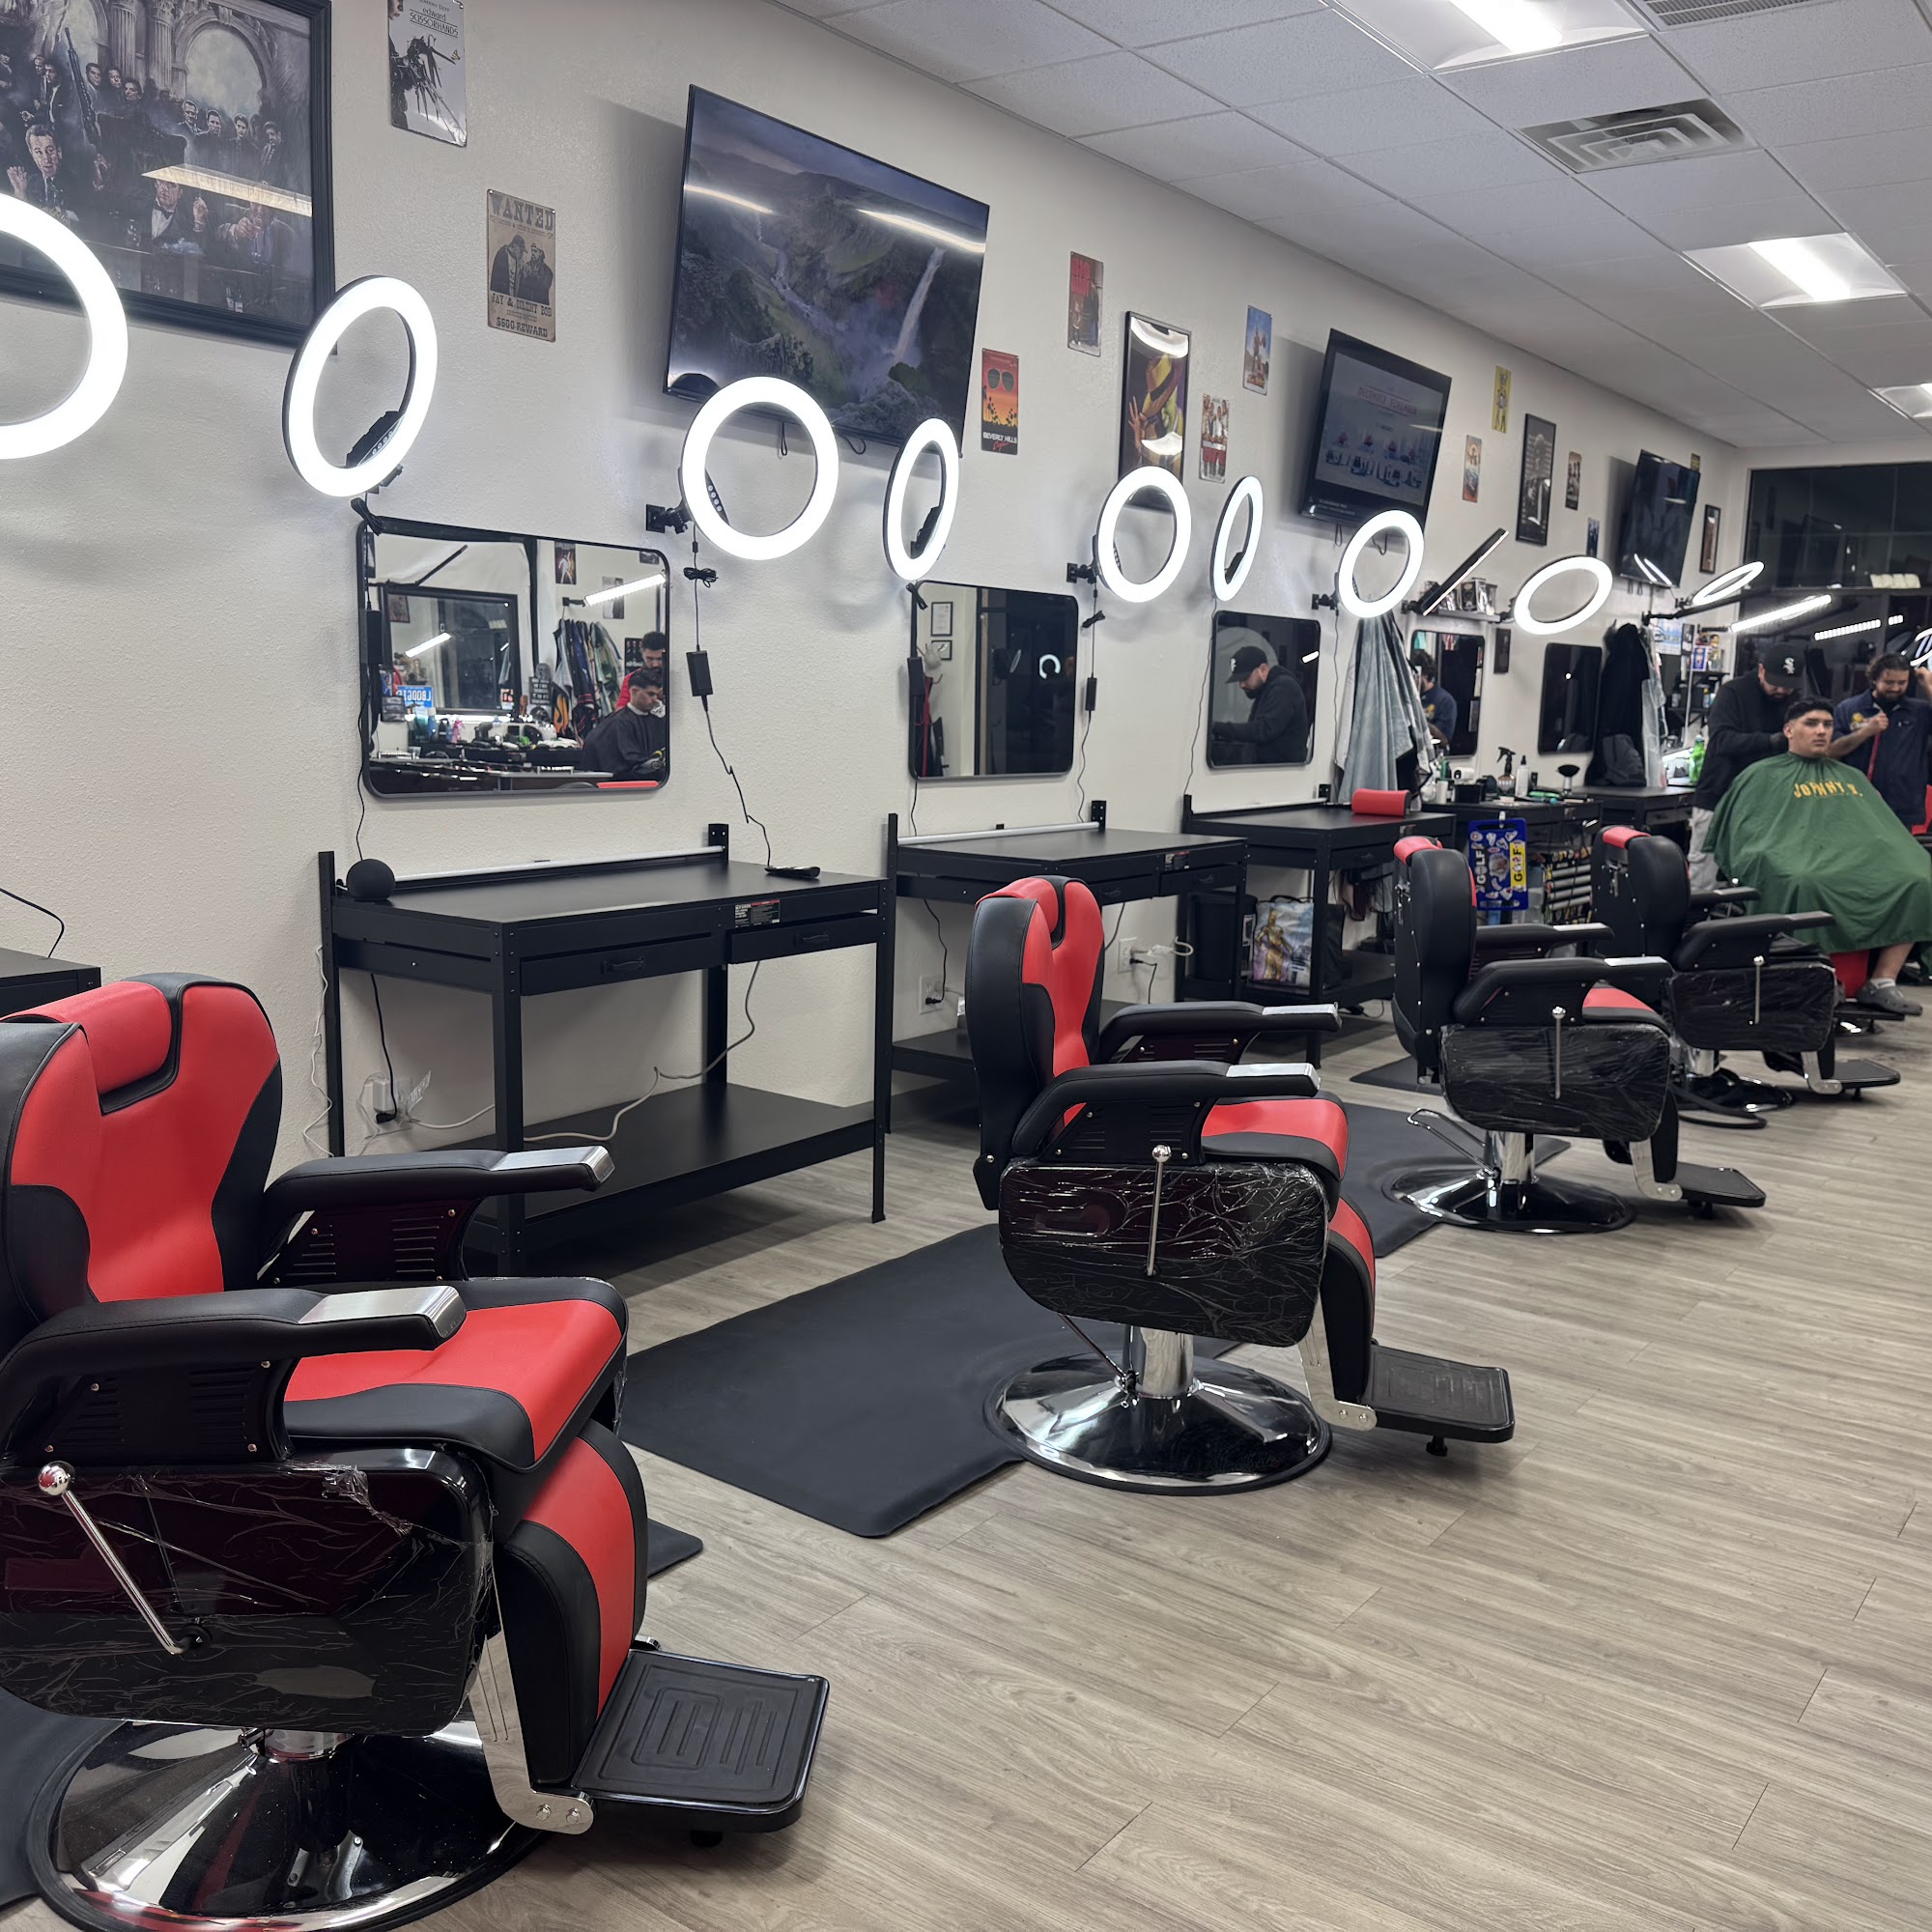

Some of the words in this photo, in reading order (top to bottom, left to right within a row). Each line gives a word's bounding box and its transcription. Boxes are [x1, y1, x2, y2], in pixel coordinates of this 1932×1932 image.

[410, 12, 459, 36] SCISSORHANDS
[490, 193, 554, 231] WANTED
[982, 431, 1004, 441] BEVERLY
[1005, 435, 1017, 444] HILLS
